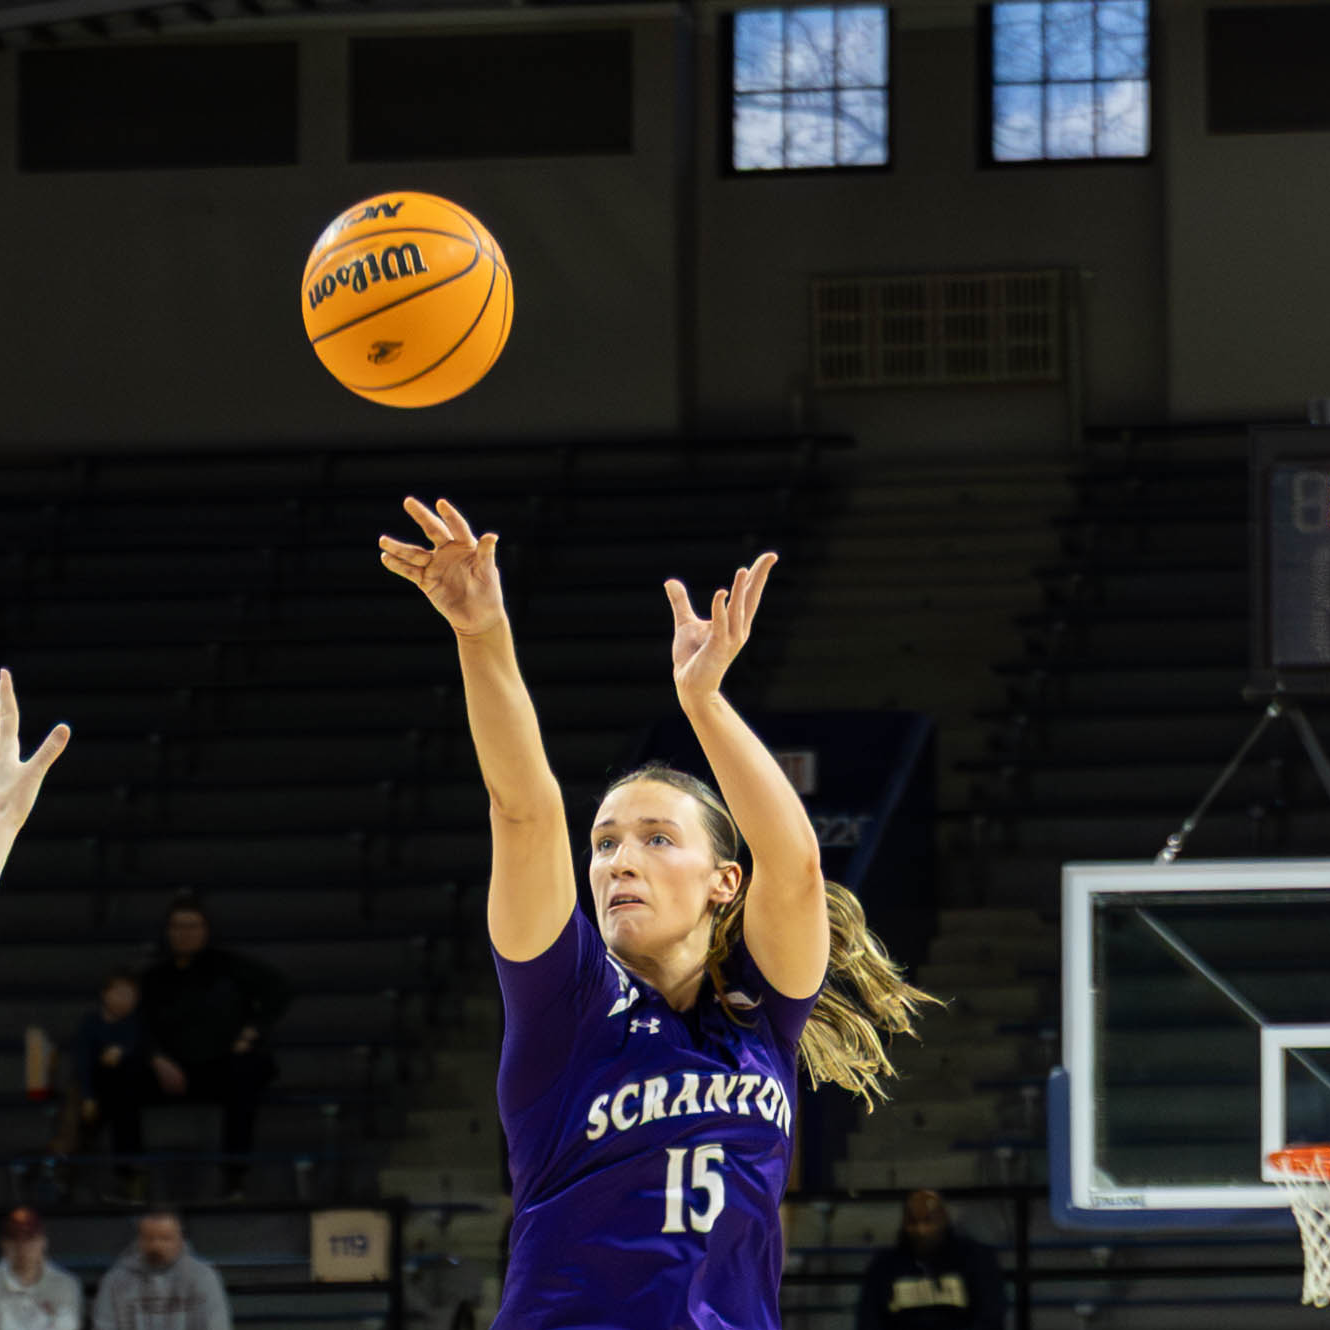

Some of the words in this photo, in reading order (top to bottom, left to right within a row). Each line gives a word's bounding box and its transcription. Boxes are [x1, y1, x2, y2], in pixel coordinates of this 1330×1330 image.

[308, 242, 430, 310] Wilson
[586, 1072, 792, 1141] SCRANTON
[661, 1144, 725, 1233] 15
